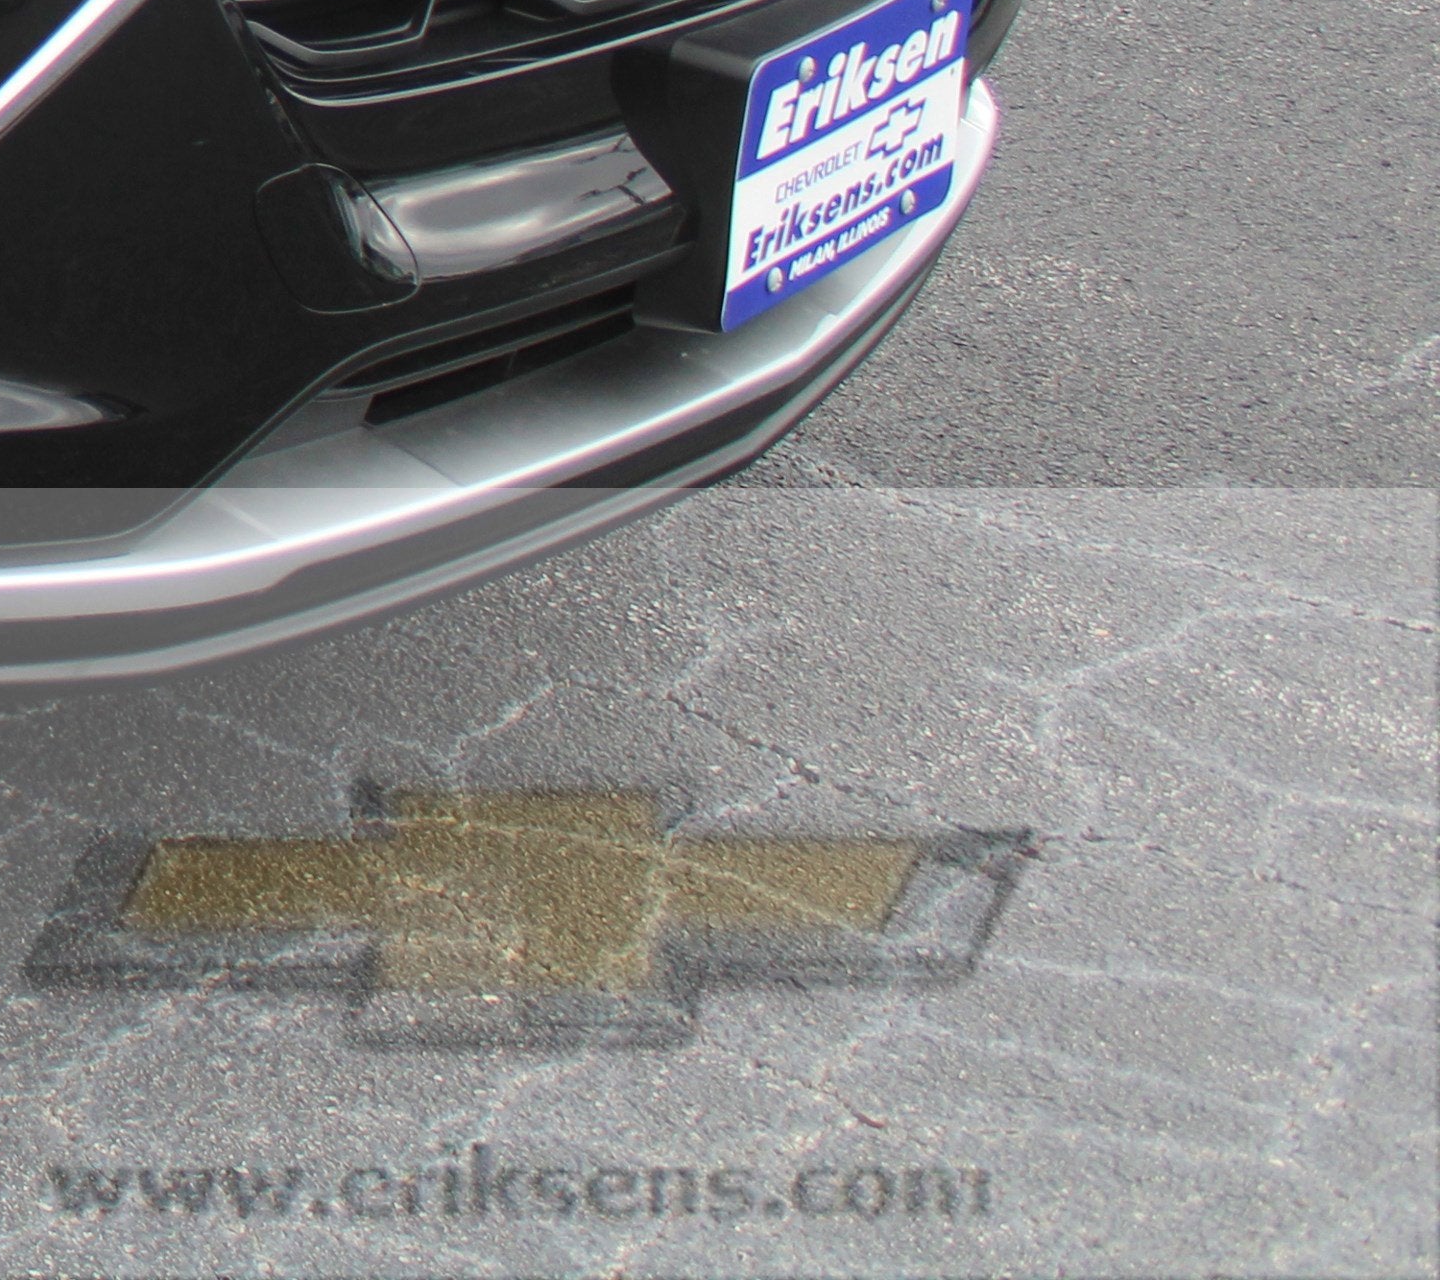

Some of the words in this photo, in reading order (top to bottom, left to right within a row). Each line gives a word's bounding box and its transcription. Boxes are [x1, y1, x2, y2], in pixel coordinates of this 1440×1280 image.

[756, 10, 959, 160] Eriksen
[742, 133, 943, 272] Eriksens.com
[775, 140, 862, 203] CHEVROLET
[838, 206, 891, 253] ILLINOIS
